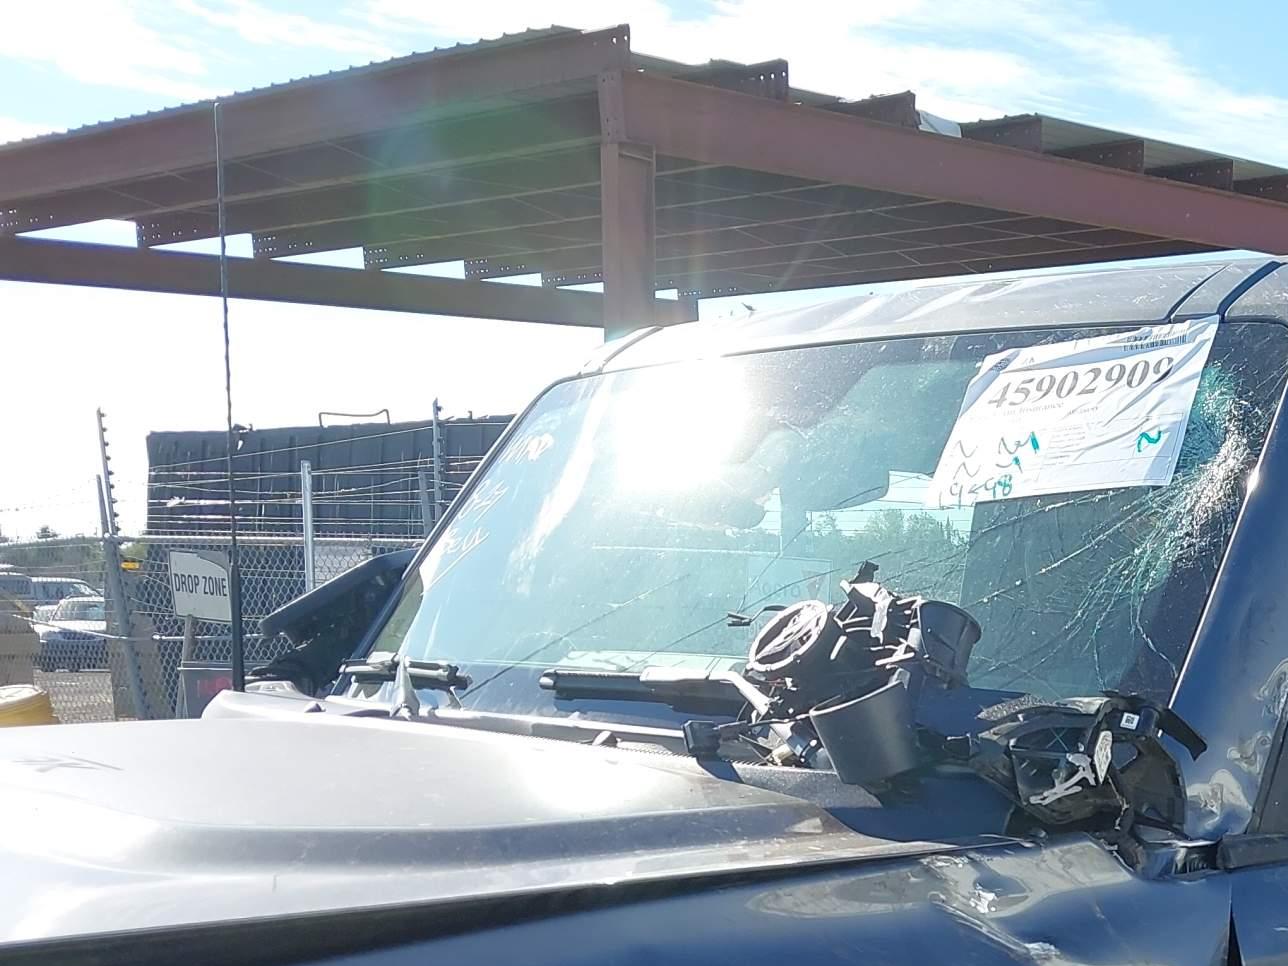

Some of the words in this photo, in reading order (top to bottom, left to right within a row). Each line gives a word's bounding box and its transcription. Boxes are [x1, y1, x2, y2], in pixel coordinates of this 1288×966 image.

[987, 356, 1175, 409] 45902909
[173, 572, 200, 594] DROP
[202, 575, 228, 597] ZONE
